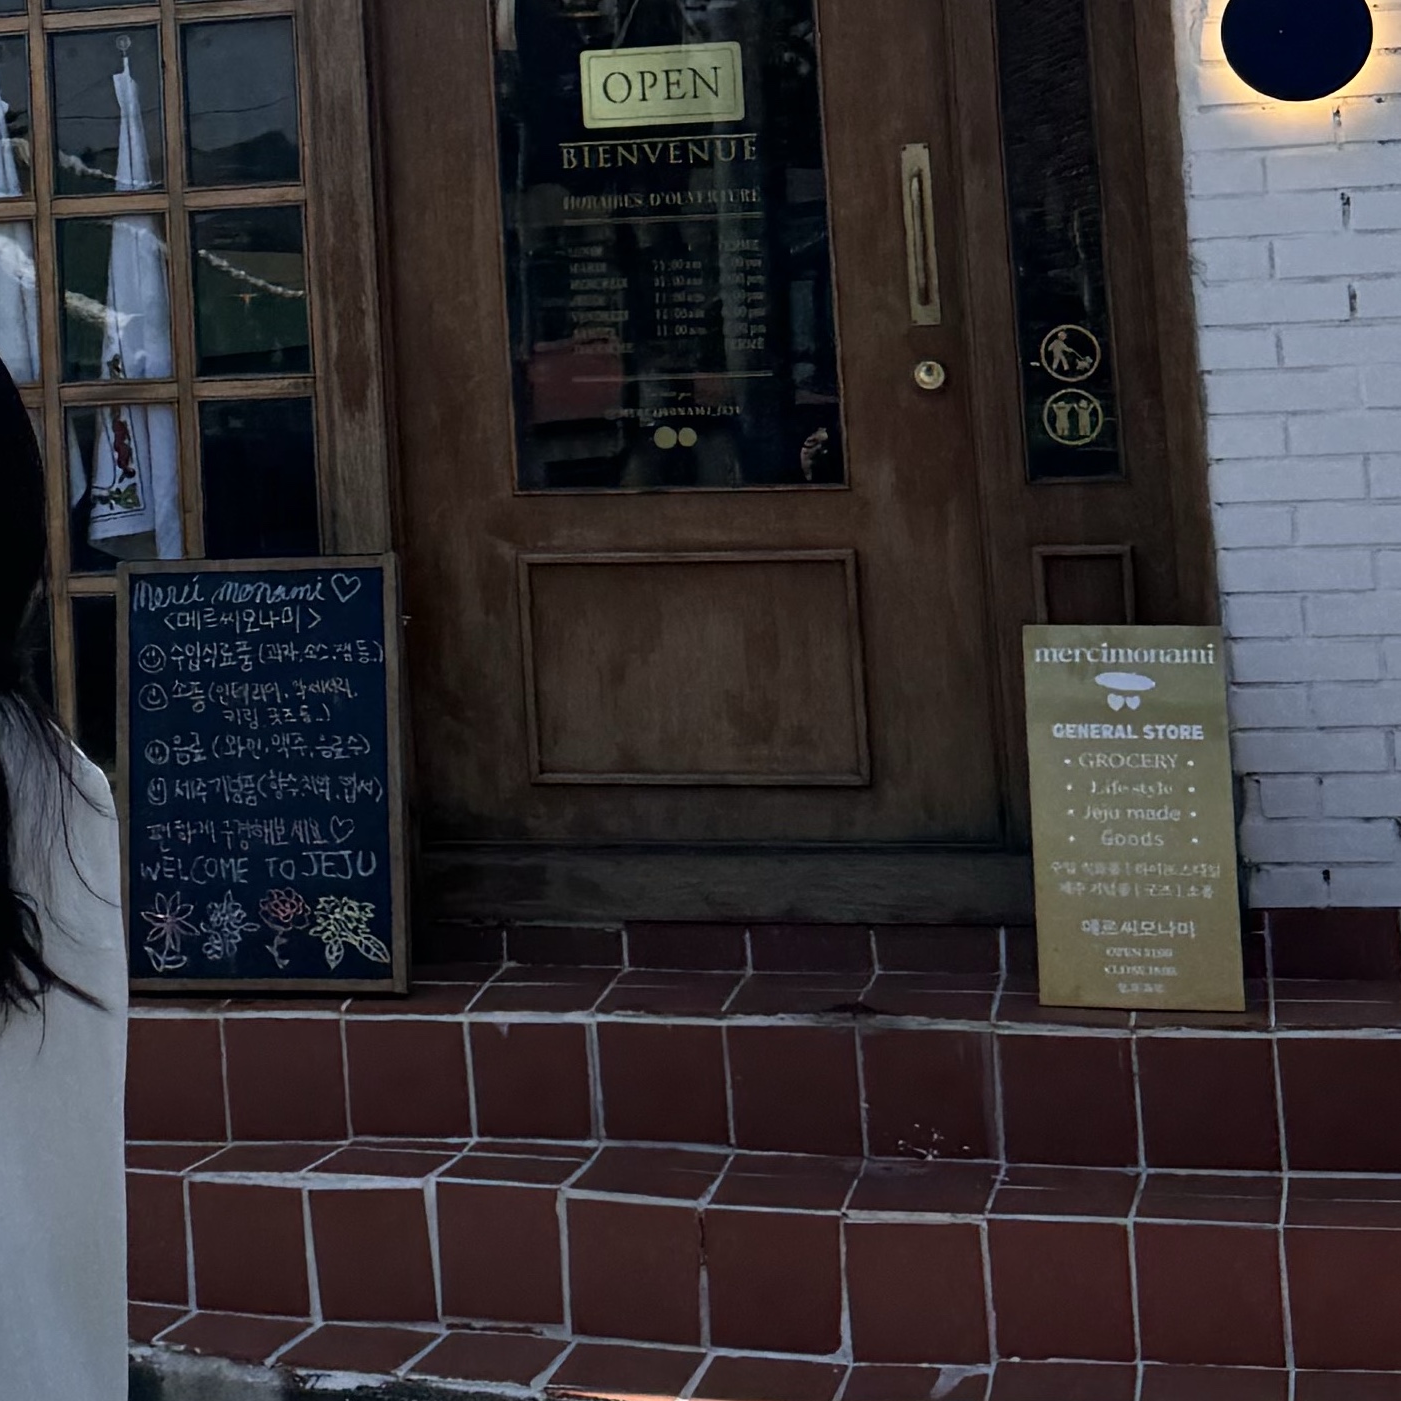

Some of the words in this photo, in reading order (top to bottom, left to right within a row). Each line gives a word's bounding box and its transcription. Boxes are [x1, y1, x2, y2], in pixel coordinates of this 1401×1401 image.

[602, 66, 723, 106] OPEN
[561, 136, 758, 170] BIENVENUE
[133, 575, 204, 612] Merci
[1035, 642, 1216, 665] mercimonami
[1052, 723, 1139, 740] GENERAL
[1142, 724, 1205, 741] STORE
[1078, 752, 1179, 770] GROCERY
[1083, 804, 1120, 823] Jeju
[1126, 805, 1182, 822] made
[1101, 828, 1165, 847] Goods
[140, 855, 249, 885] WELCOME
[264, 856, 296, 881] TO
[301, 850, 377, 880] JEJU
